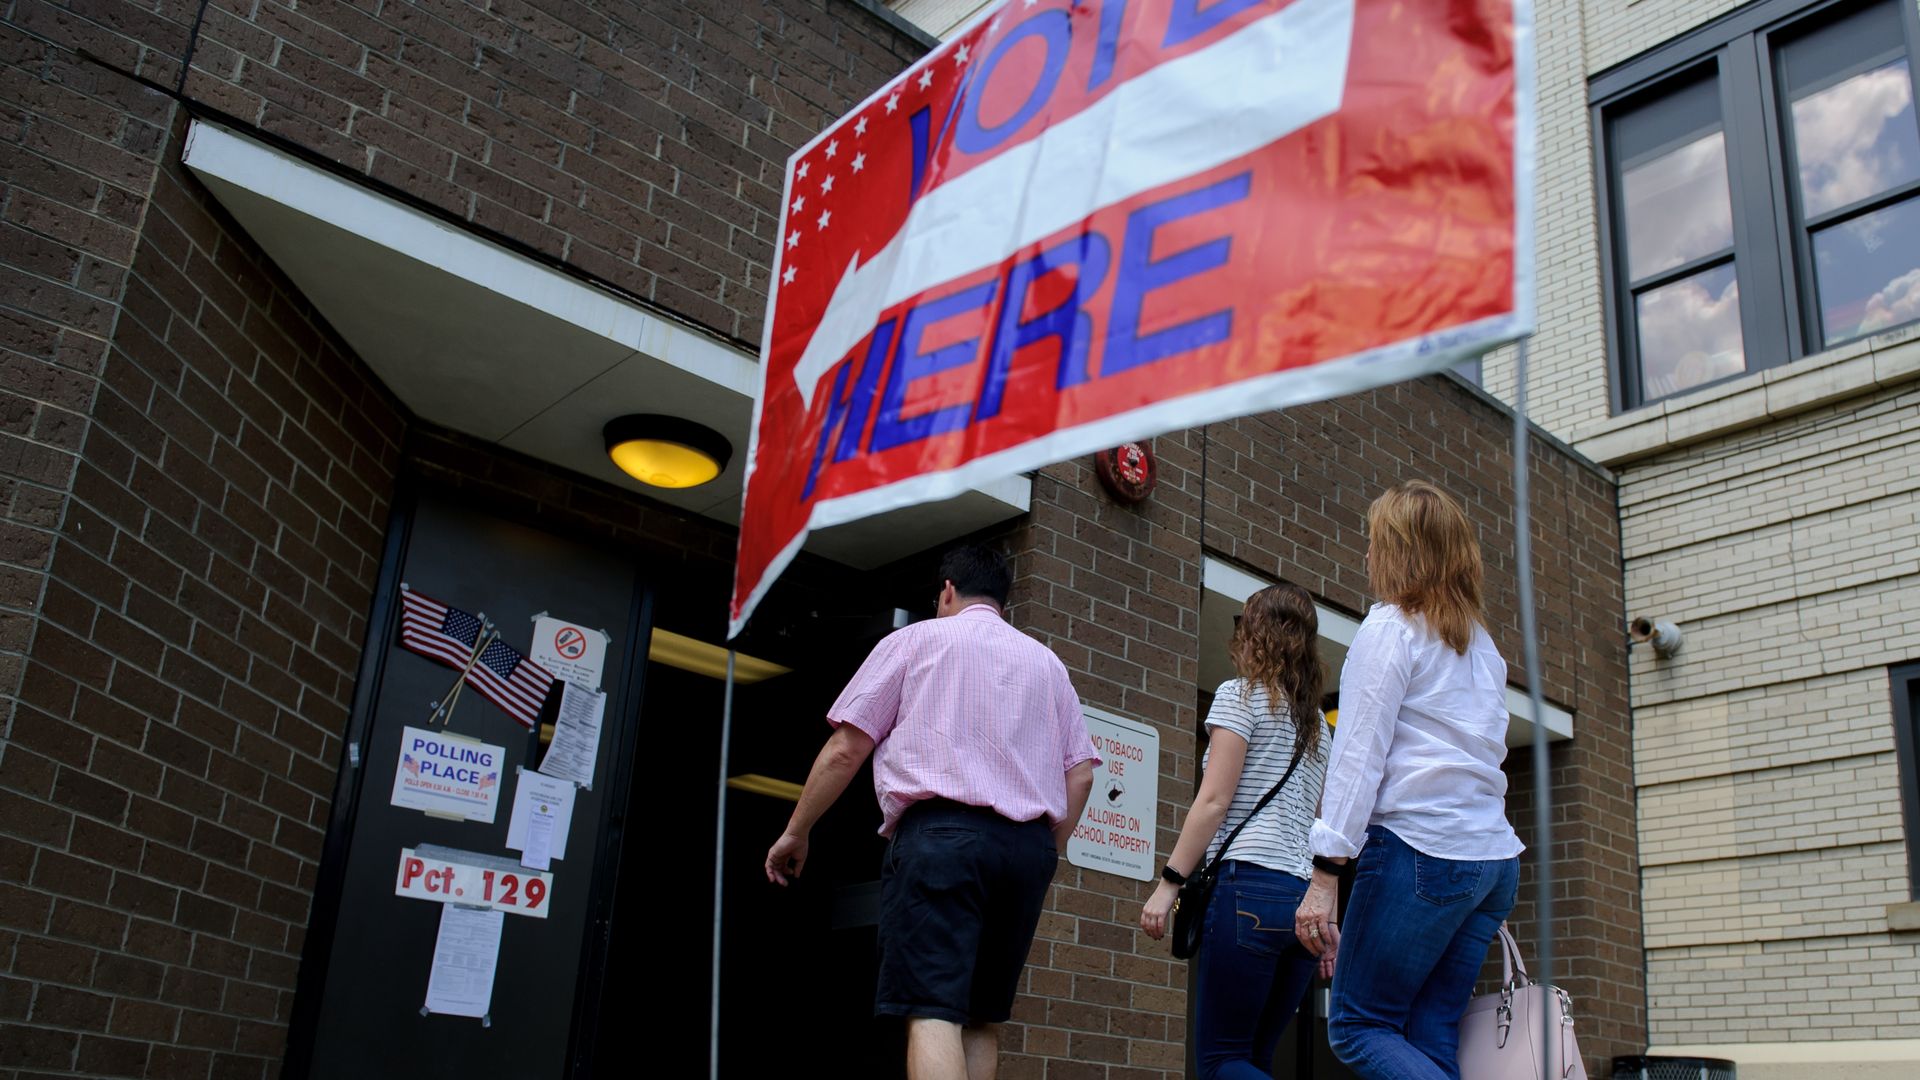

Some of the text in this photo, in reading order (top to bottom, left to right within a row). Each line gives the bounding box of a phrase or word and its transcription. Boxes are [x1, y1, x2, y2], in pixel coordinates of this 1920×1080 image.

[801, 171, 1251, 501] HERE
[413, 739, 493, 768] POLLING
[1105, 738, 1143, 763] TOBACCO
[420, 761, 480, 785] PLACE
[1108, 759, 1124, 777] USE
[1087, 806, 1141, 833] ALLOWED ON
[1072, 824, 1151, 855] SCHOOL PROPERTY
[402, 857, 546, 908] Pct. 129
